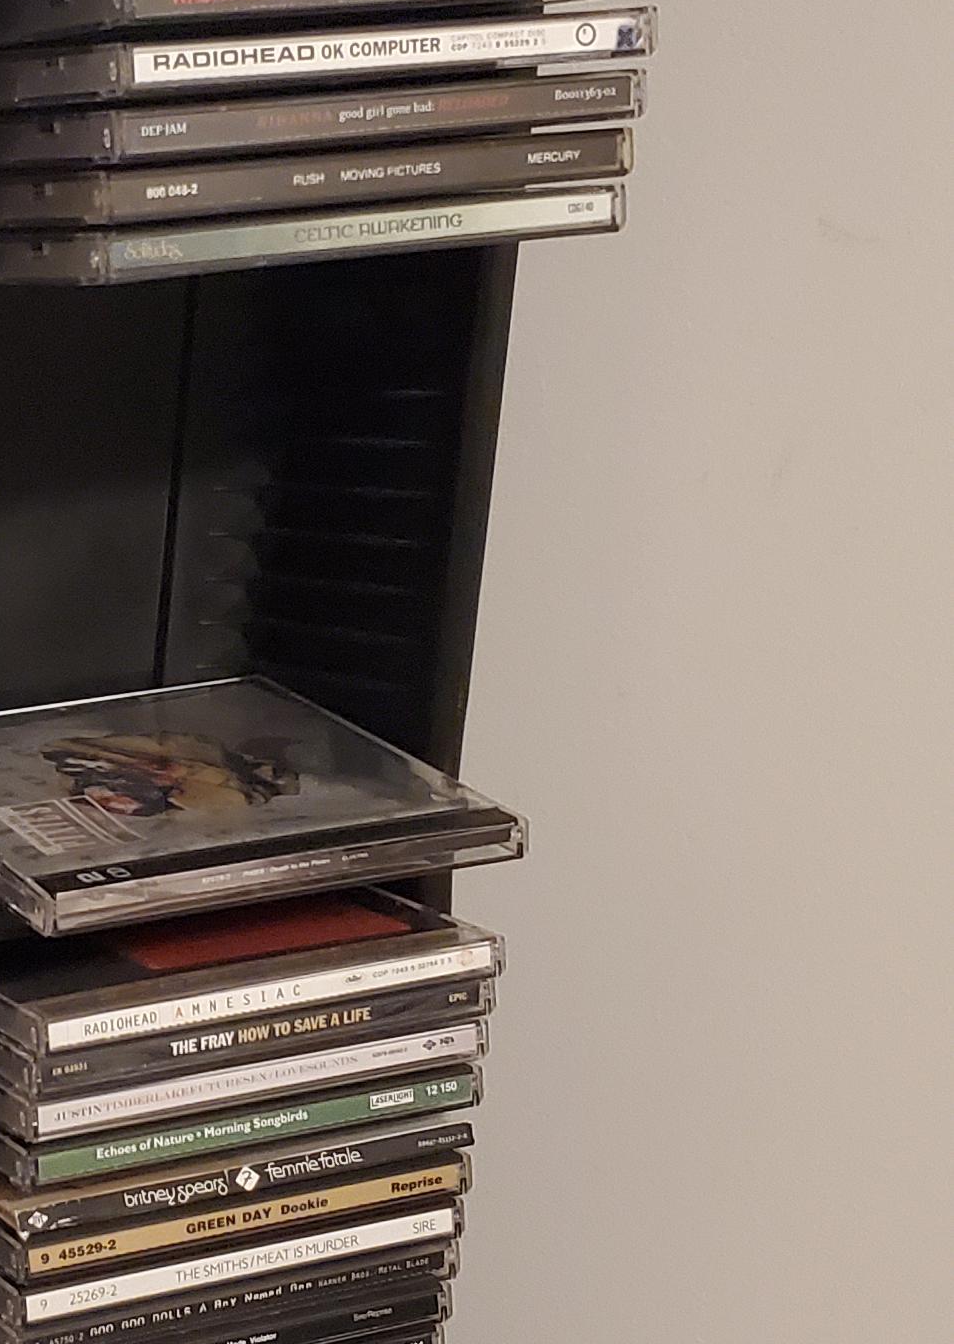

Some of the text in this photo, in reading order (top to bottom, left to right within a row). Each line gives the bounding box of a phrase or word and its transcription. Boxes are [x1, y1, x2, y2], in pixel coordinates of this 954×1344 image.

[153, 36, 441, 71] RADIOHEAD OK COMPUTER
[340, 161, 441, 182] MOVING PICTURES
[527, 148, 582, 165] MERCURY
[293, 172, 326, 187] RUSH
[294, 213, 463, 244] CELTIC AWAKENING
[83, 983, 302, 1037] RADIOHEAD AMNESIAC
[170, 1006, 372, 1057] THE FRAY HOW TO SAVE A LIFE
[96, 1110, 309, 1160] Echoes of Nature Morning Songbirds
[123, 1169, 229, 1208] britney spears
[391, 1175, 443, 1194] Reprise
[186, 1197, 329, 1235] GREEN DAY Dookie
[412, 1219, 437, 1234] SIRE
